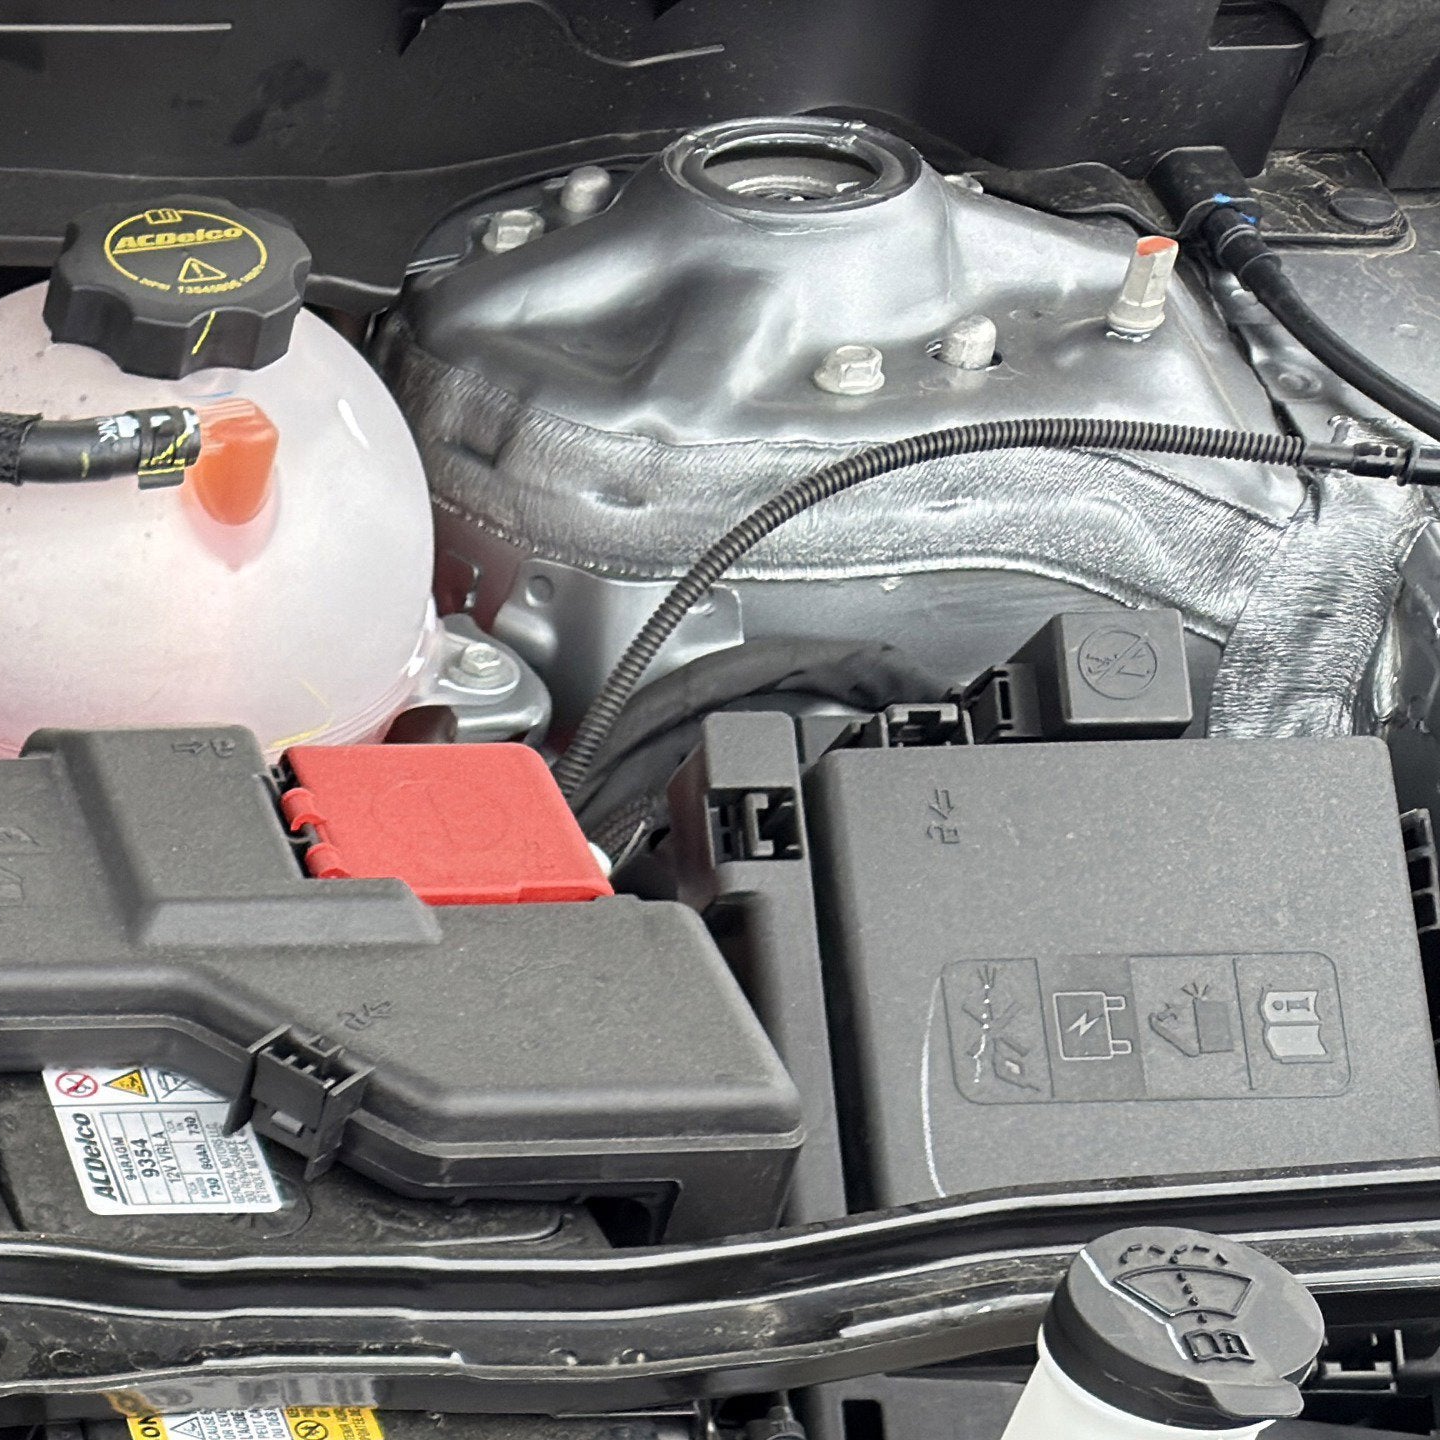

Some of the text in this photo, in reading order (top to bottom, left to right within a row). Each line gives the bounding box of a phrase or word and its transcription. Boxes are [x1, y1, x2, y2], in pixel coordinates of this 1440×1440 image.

[115, 228, 243, 250] ACDelco
[183, 1116, 200, 1134] 730
[73, 1113, 116, 1199] ACDelco
[130, 1138, 159, 1177] 9354
[151, 1130, 181, 1183] 12V VRLA
[206, 1177, 222, 1196] 730
[201, 1416, 220, 1440] CAUSE
[221, 1429, 235, 1439] OR
[252, 1420, 269, 1439] PEUT
[270, 1427, 285, 1438] OU
